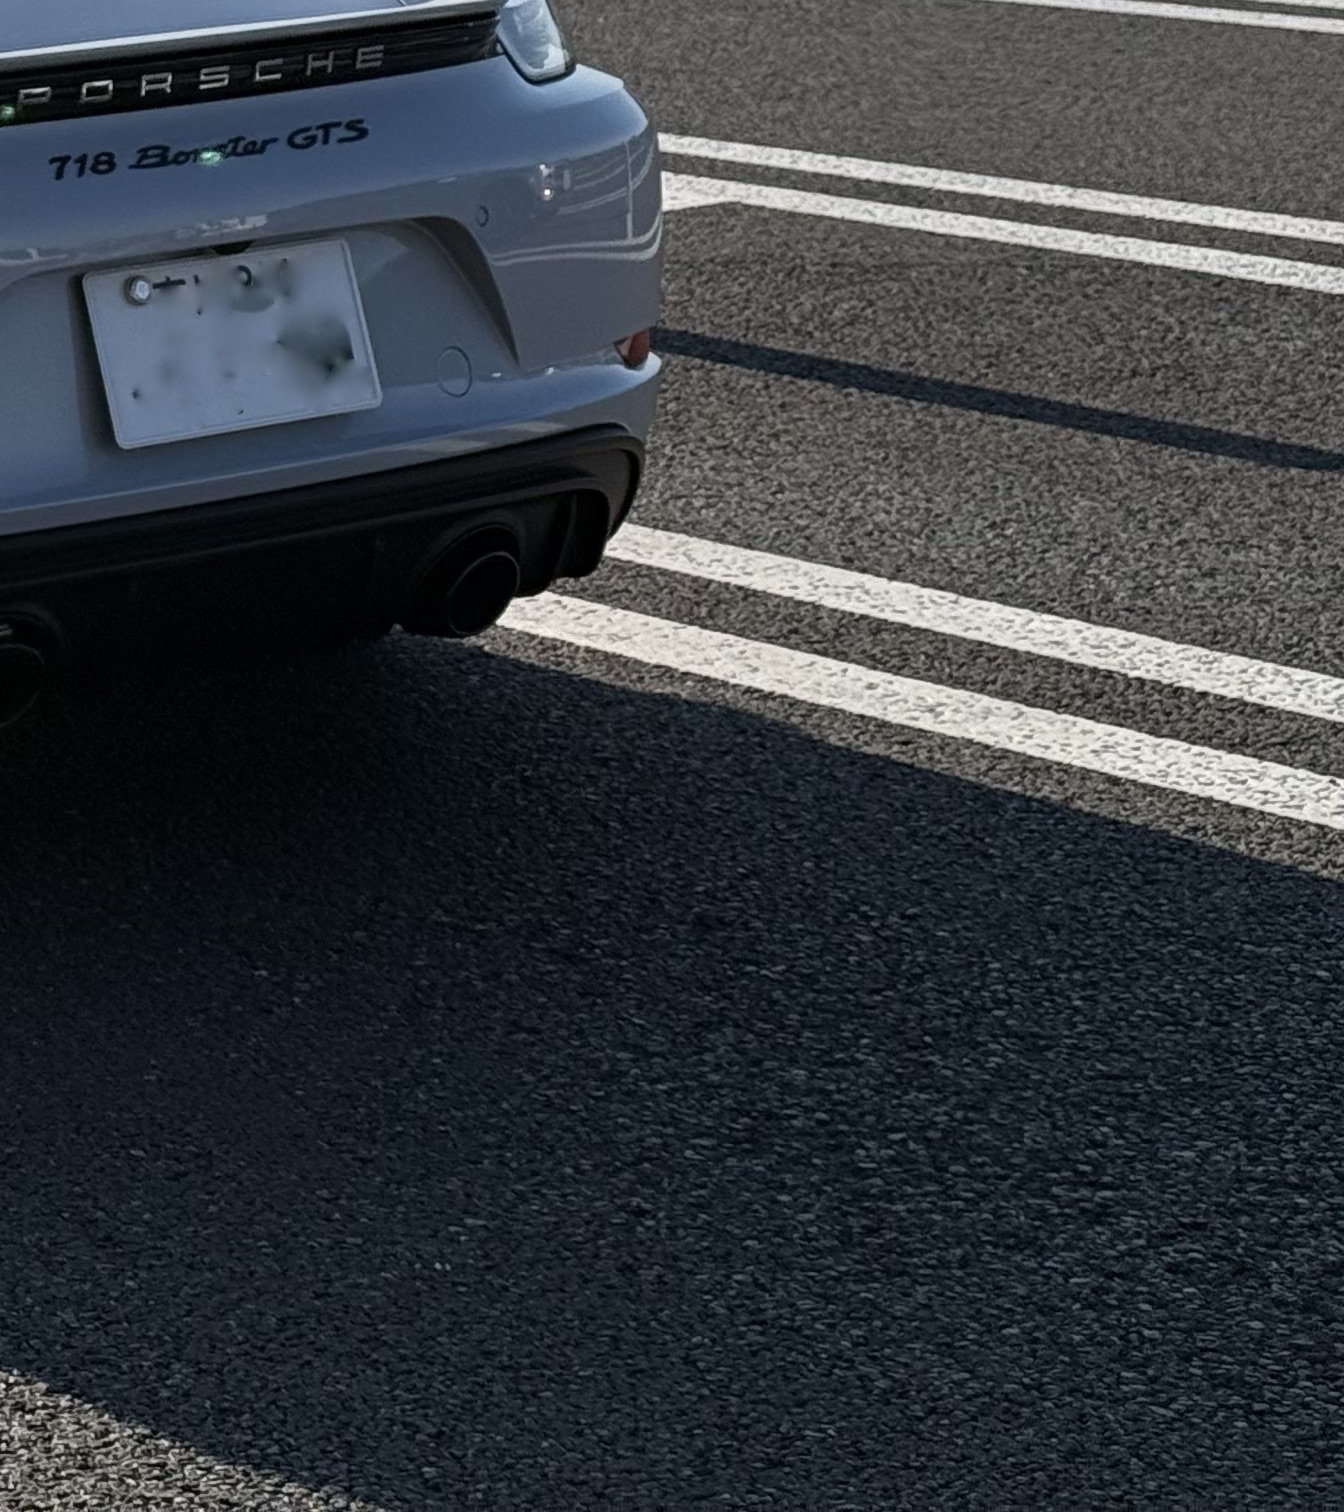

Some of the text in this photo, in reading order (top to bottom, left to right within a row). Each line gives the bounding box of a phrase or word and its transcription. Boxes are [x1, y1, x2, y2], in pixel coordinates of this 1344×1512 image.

[17, 44, 385, 111] PORSCHE
[48, 151, 118, 181] 718
[286, 118, 370, 150] GTS
